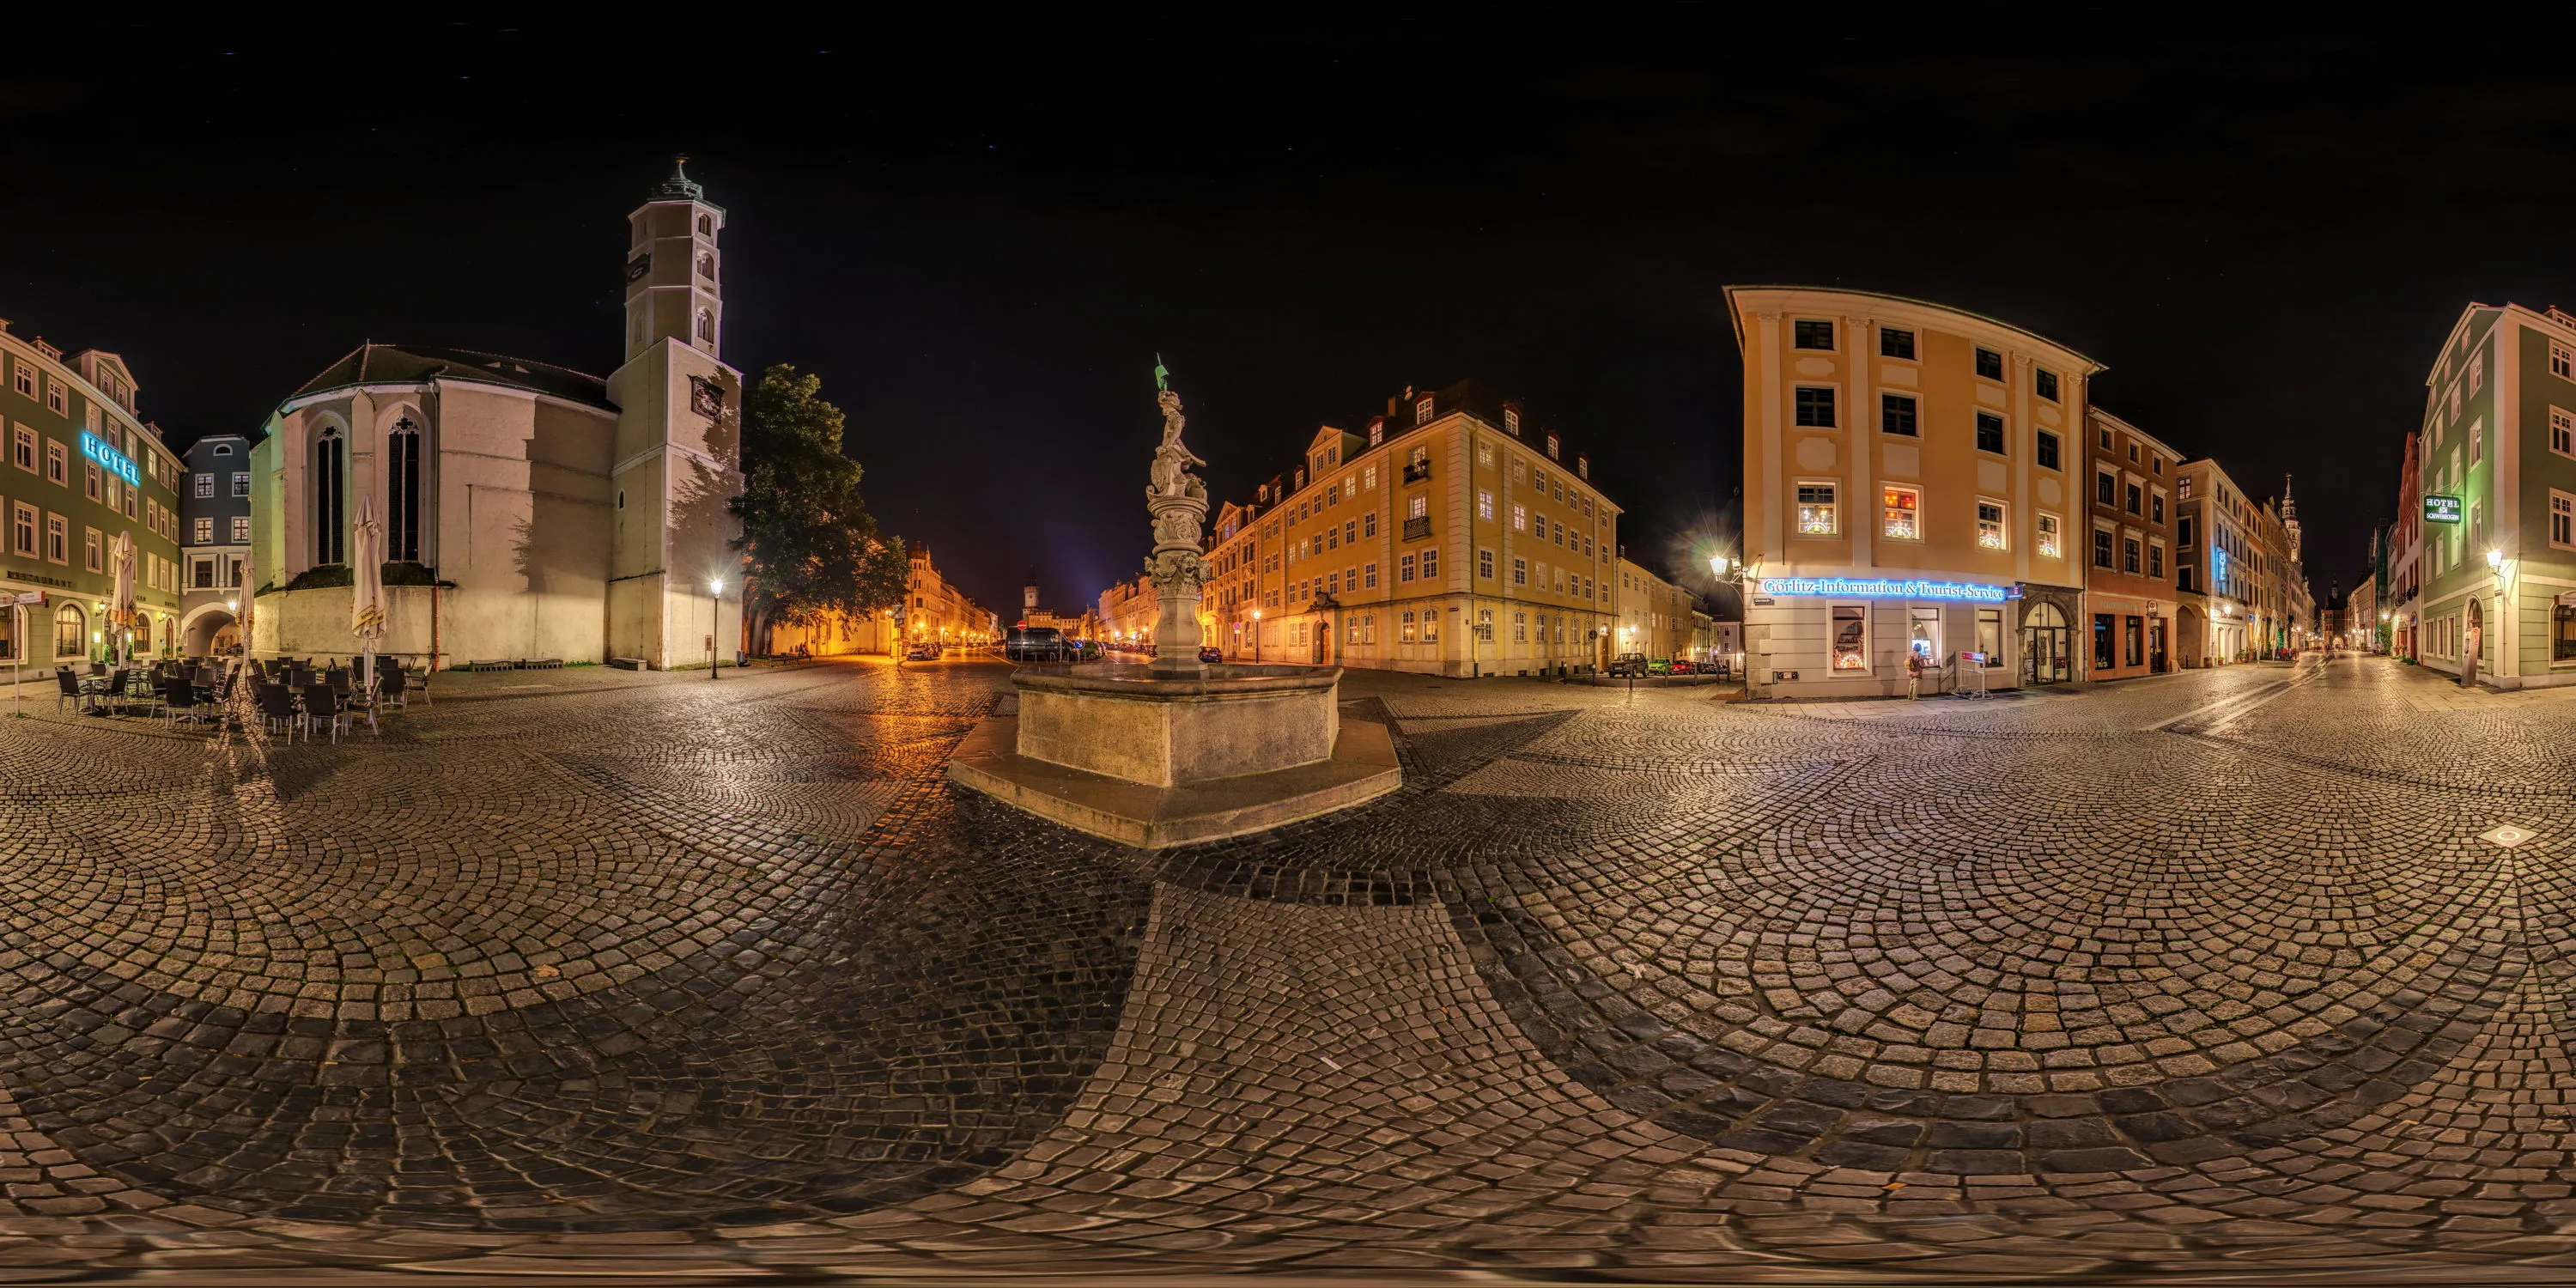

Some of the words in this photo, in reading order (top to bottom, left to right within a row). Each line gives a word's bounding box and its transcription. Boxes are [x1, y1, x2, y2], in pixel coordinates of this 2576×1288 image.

[85, 435, 140, 483] HOTEL
[2425, 498, 2459, 507] HOTEL
[7, 570, 72, 587] RESTAURANT
[1764, 579, 1903, 593] Görlitz-Information
[1905, 582, 1916, 593] &
[1918, 582, 2004, 598] Tourist-Service
